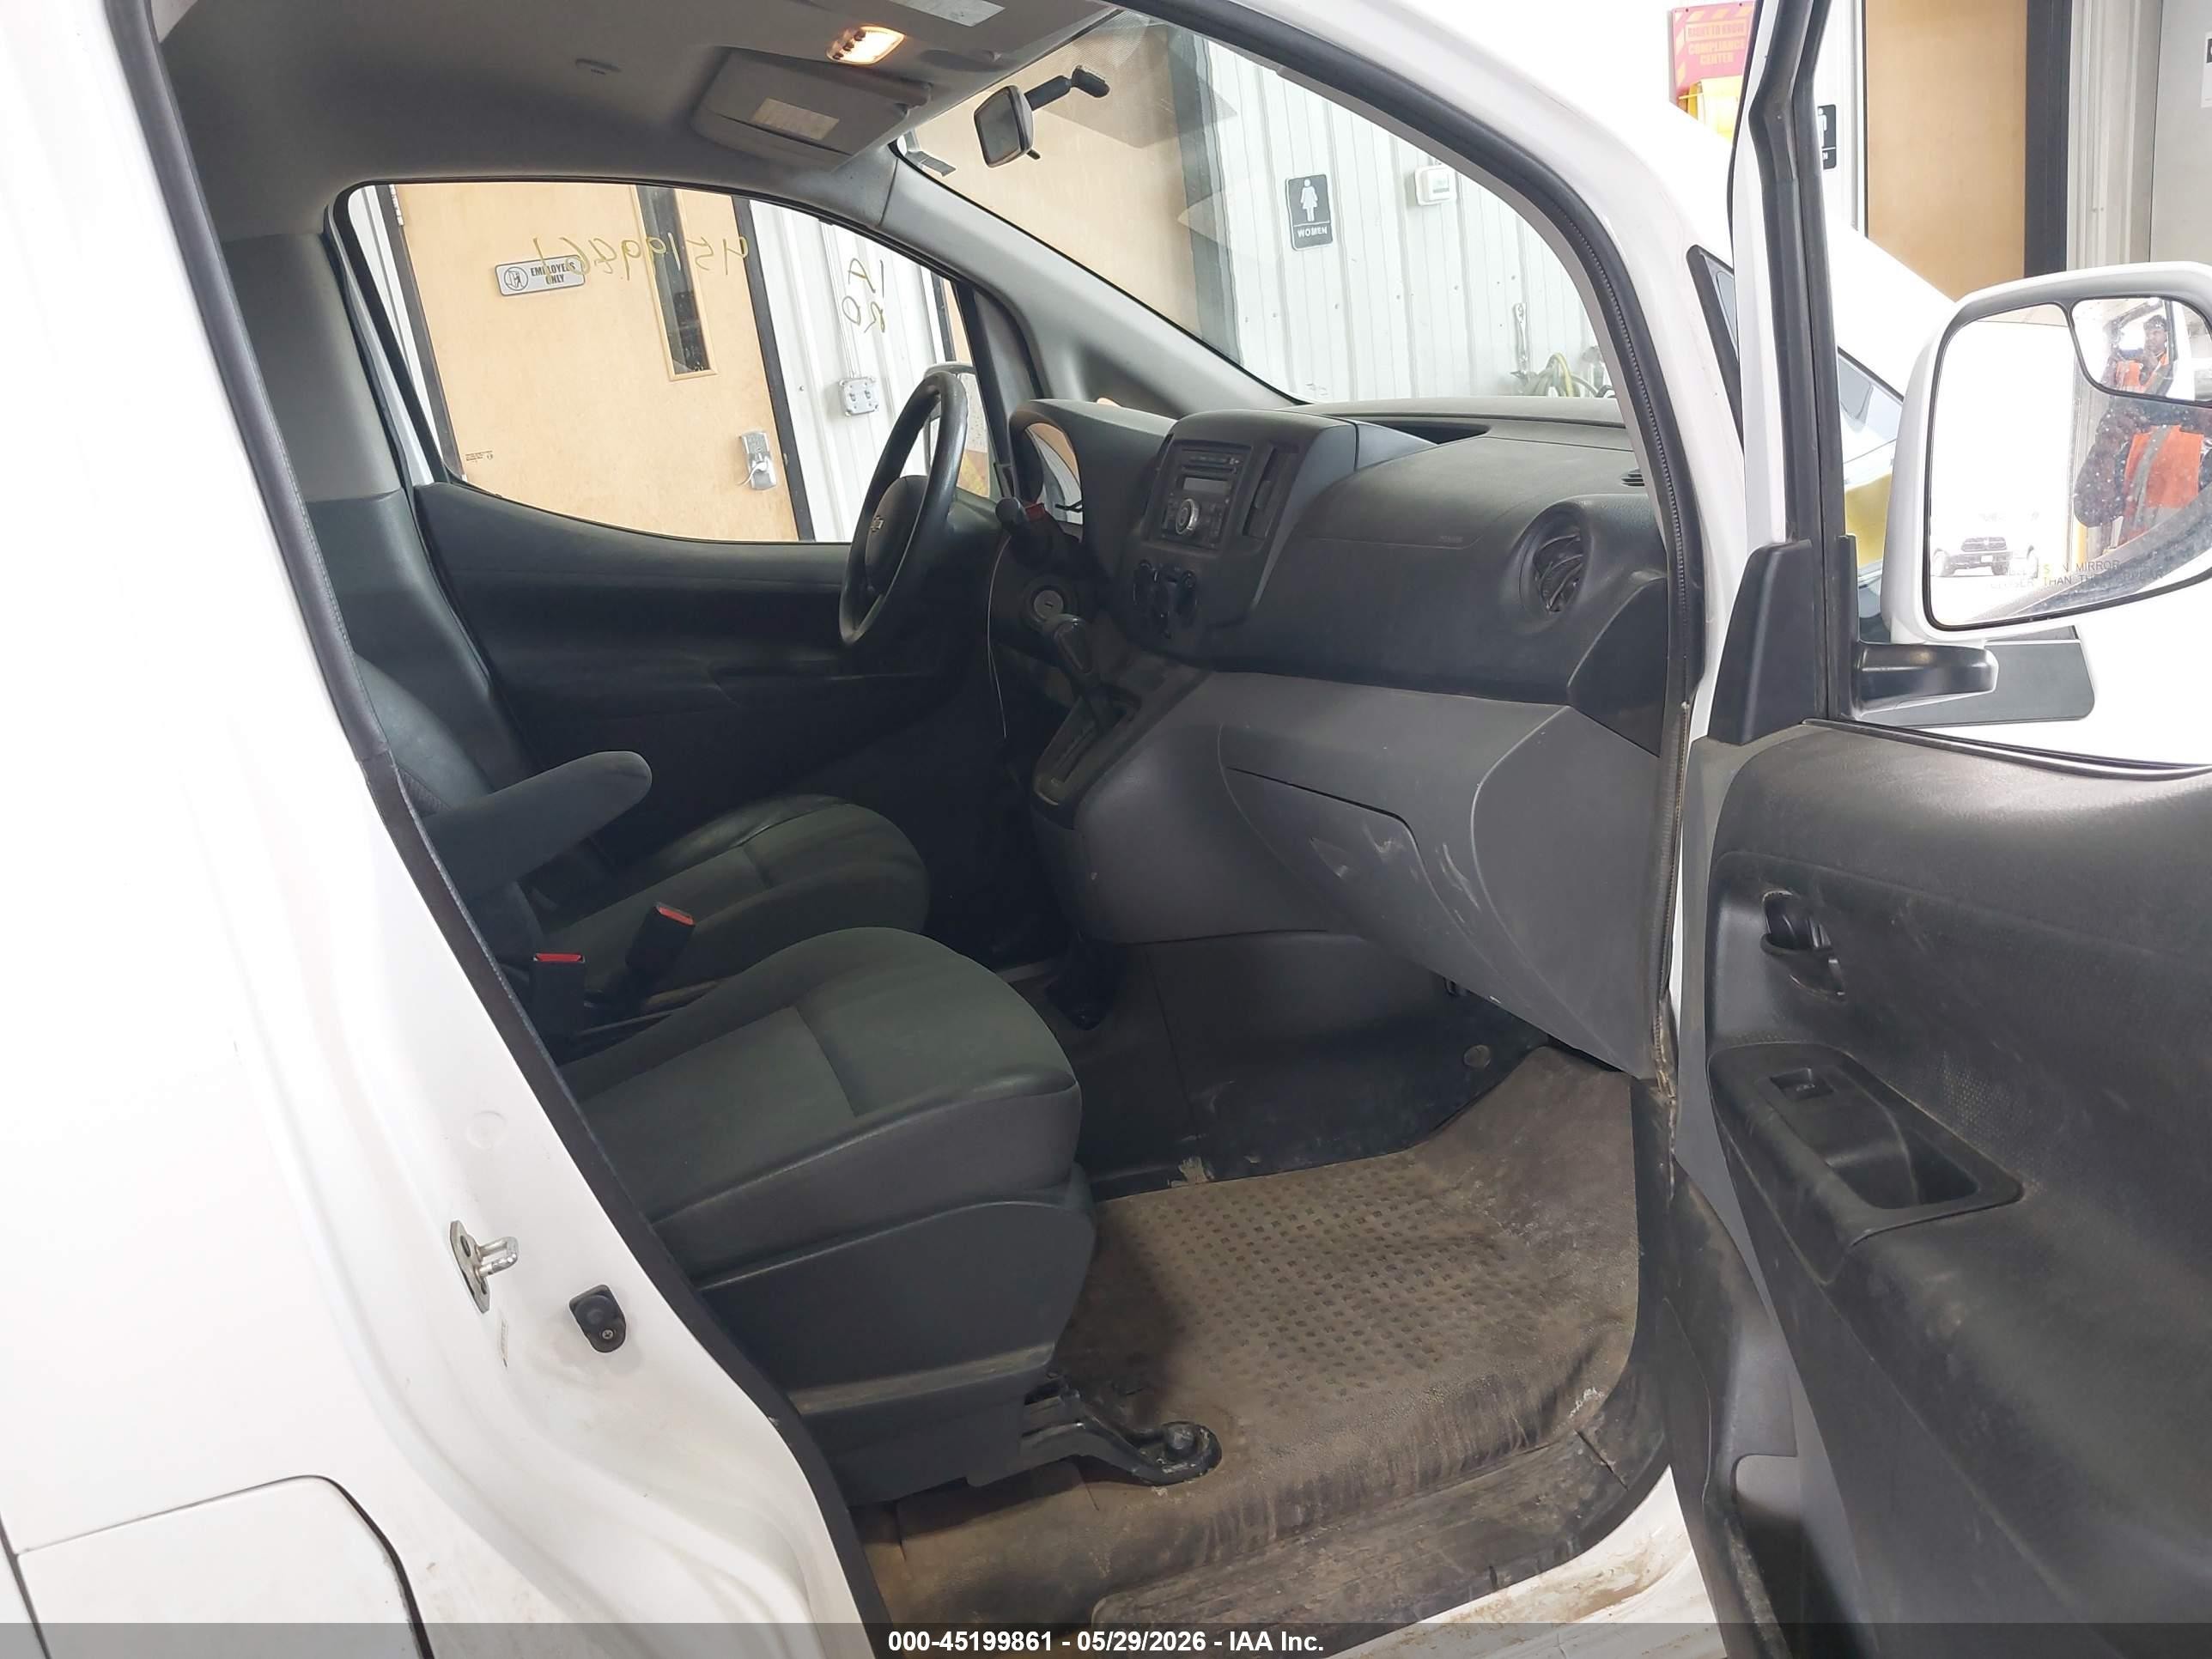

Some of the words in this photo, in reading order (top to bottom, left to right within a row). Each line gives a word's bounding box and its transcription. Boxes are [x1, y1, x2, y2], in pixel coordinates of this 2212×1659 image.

[1688, 40, 1746, 55] COMPLIANCE
[1699, 52, 1733, 65] CENTER
[1297, 226, 1328, 238] WOMEN
[545, 274, 565, 285] ONLY
[2075, 560, 2120, 572] MIRROR
